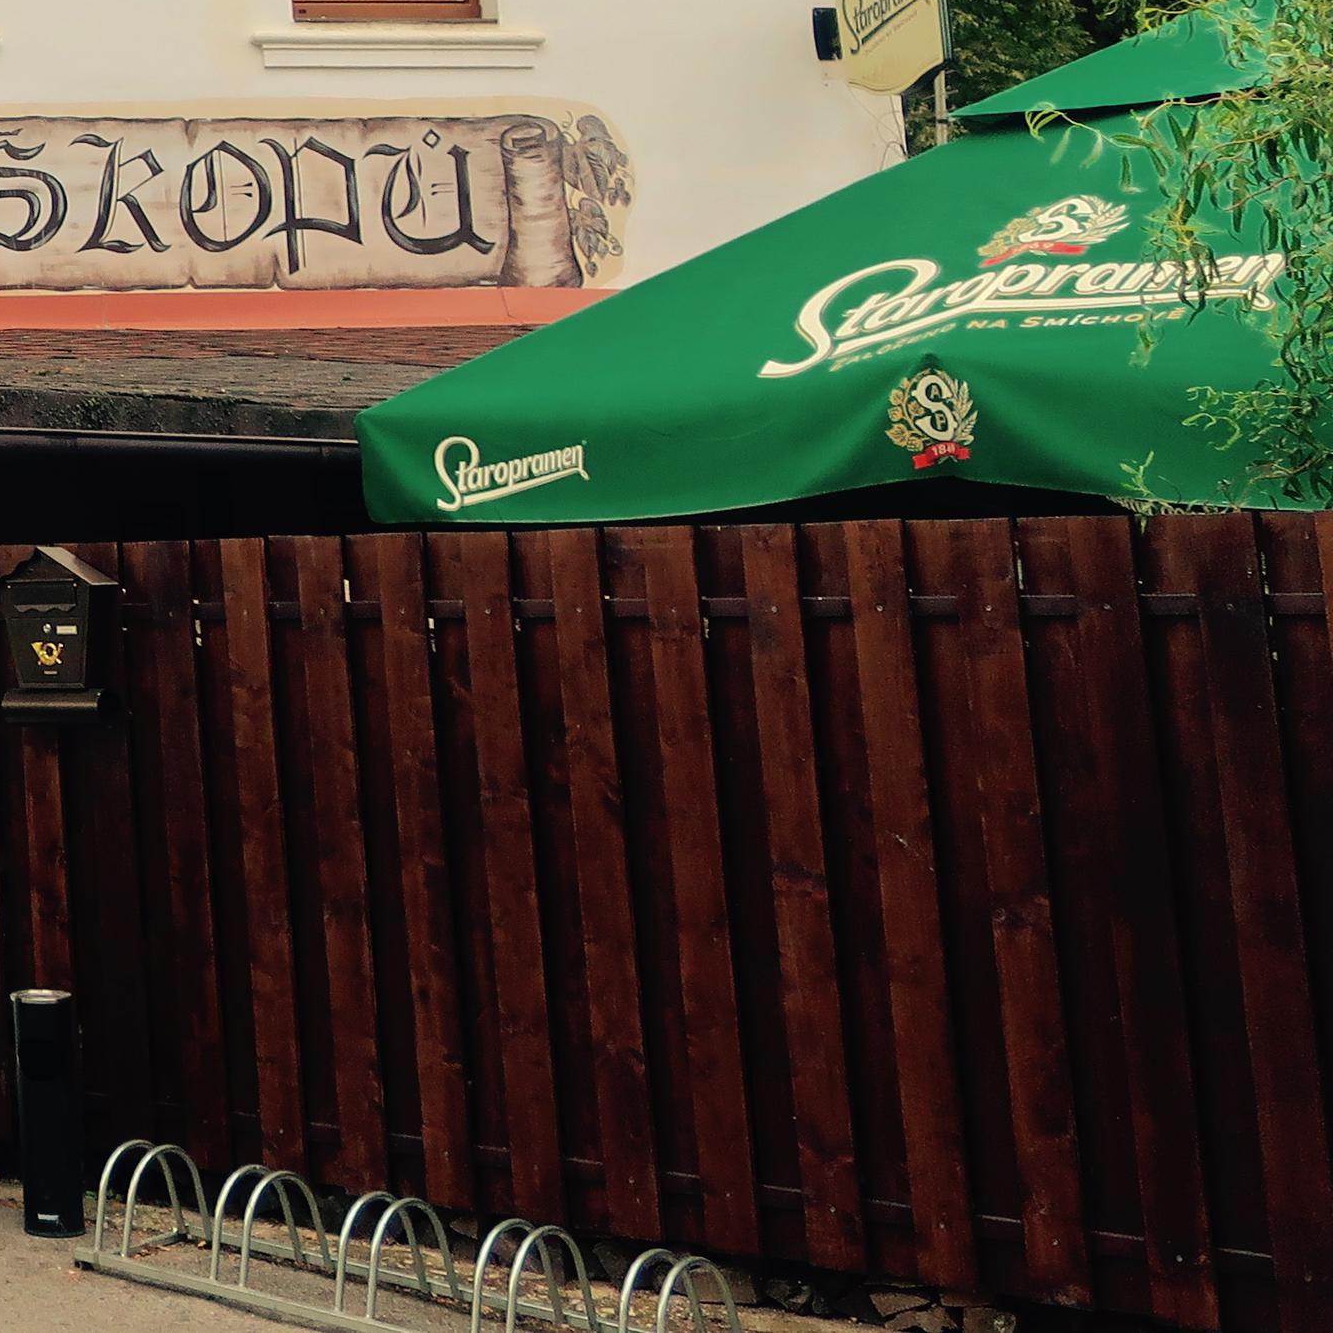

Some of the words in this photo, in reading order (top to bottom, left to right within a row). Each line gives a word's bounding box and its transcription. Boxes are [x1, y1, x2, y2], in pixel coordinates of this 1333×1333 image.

[757, 253, 1287, 378] Staropramen
[966, 318, 1008, 330] NA
[434, 435, 591, 512] Staropramen
